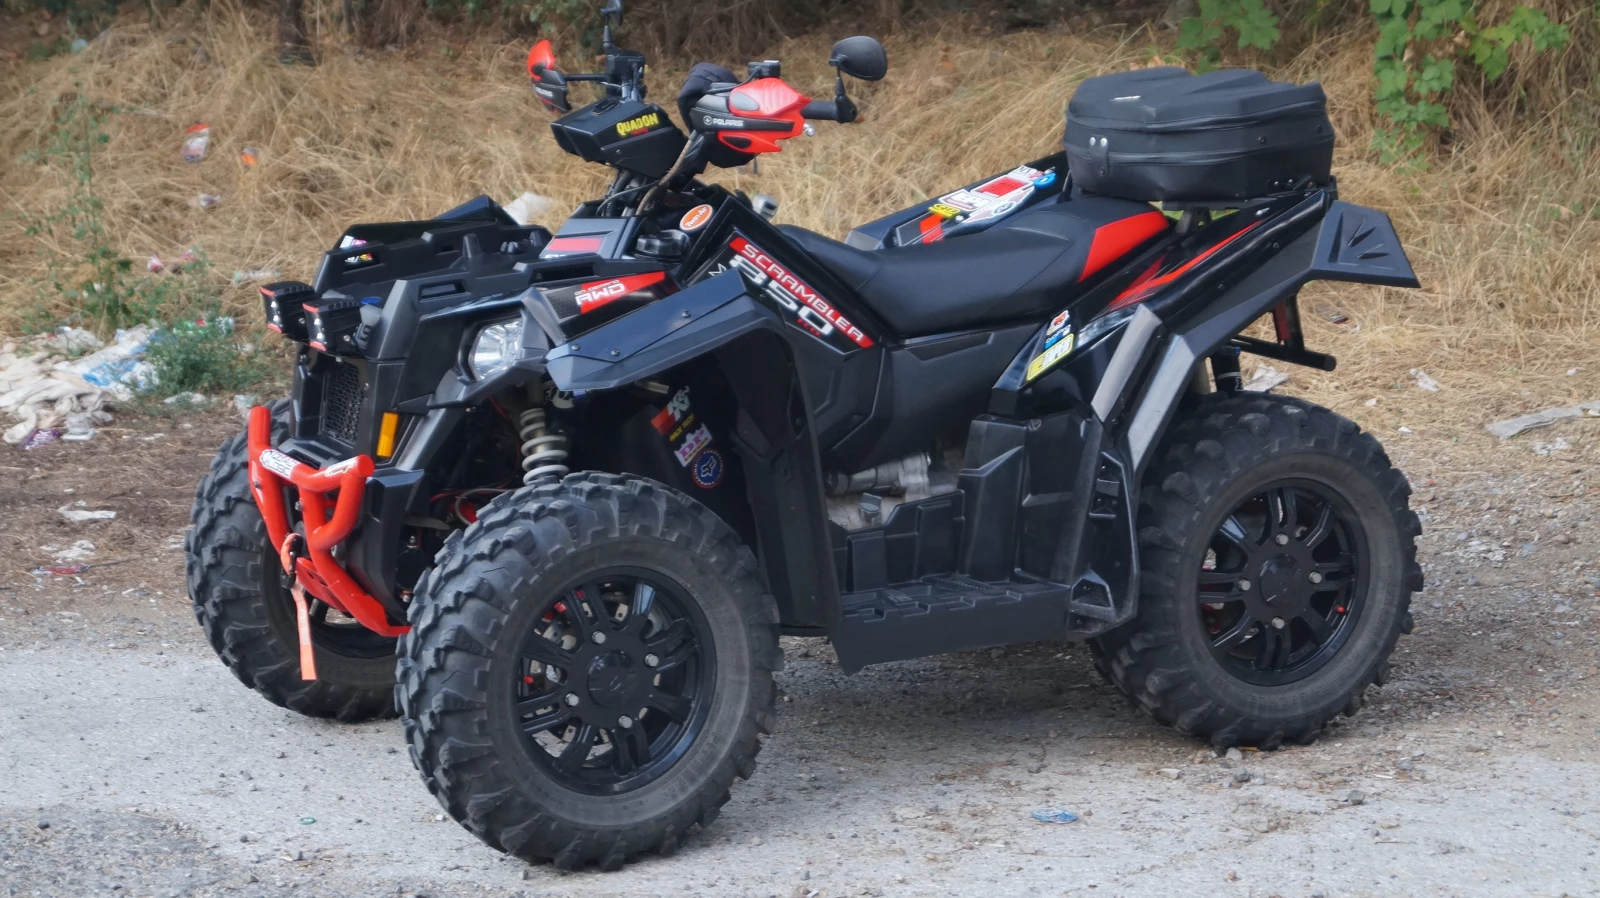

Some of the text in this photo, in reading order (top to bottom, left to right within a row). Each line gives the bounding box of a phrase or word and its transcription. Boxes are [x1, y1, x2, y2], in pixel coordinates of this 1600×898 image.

[616, 112, 659, 136] QUADON
[712, 117, 744, 128] POLARIS
[575, 283, 626, 306] AWD
[729, 254, 835, 335] 850
[743, 243, 865, 342] SCRAMBLER
